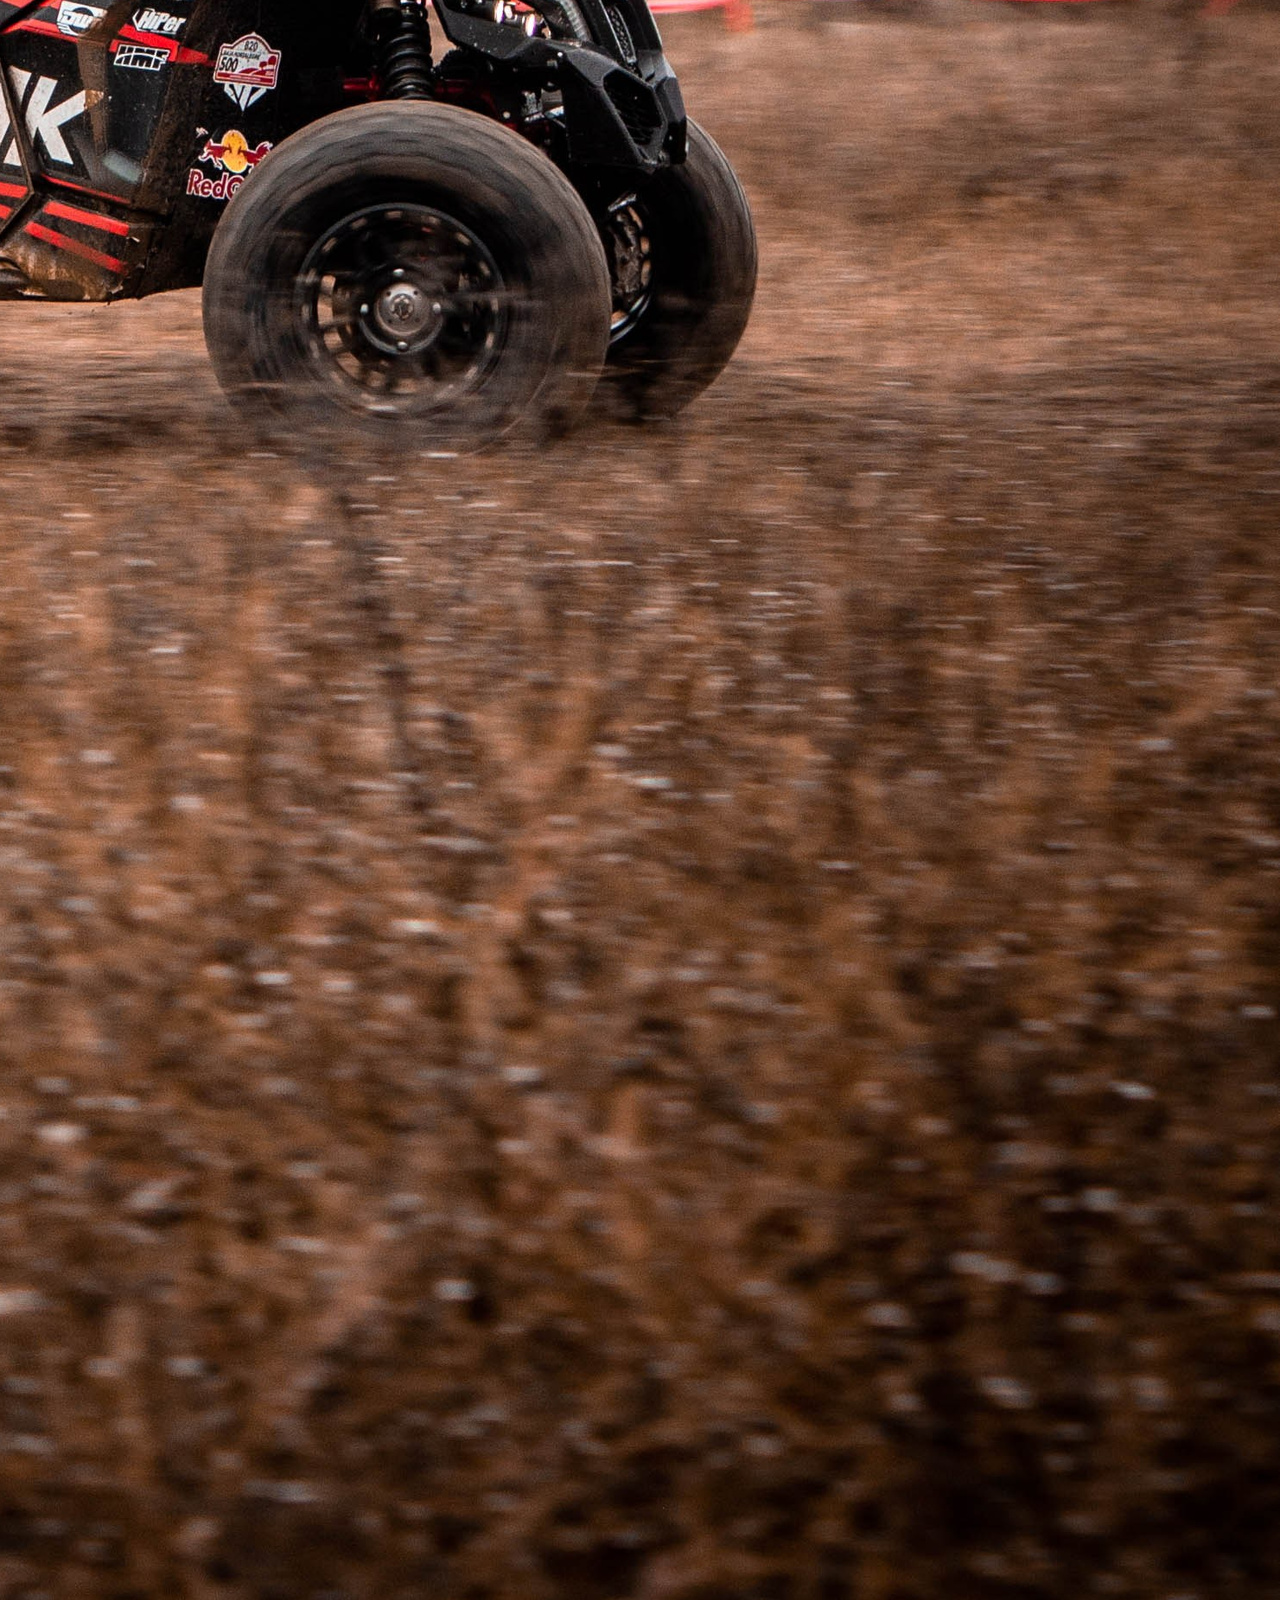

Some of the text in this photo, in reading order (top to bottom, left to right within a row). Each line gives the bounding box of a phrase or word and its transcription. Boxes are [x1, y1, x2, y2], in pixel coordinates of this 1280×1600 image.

[137, 9, 187, 35] HiPer
[244, 40, 259, 52] 820
[113, 43, 170, 71] HMF
[219, 56, 239, 73] 500
